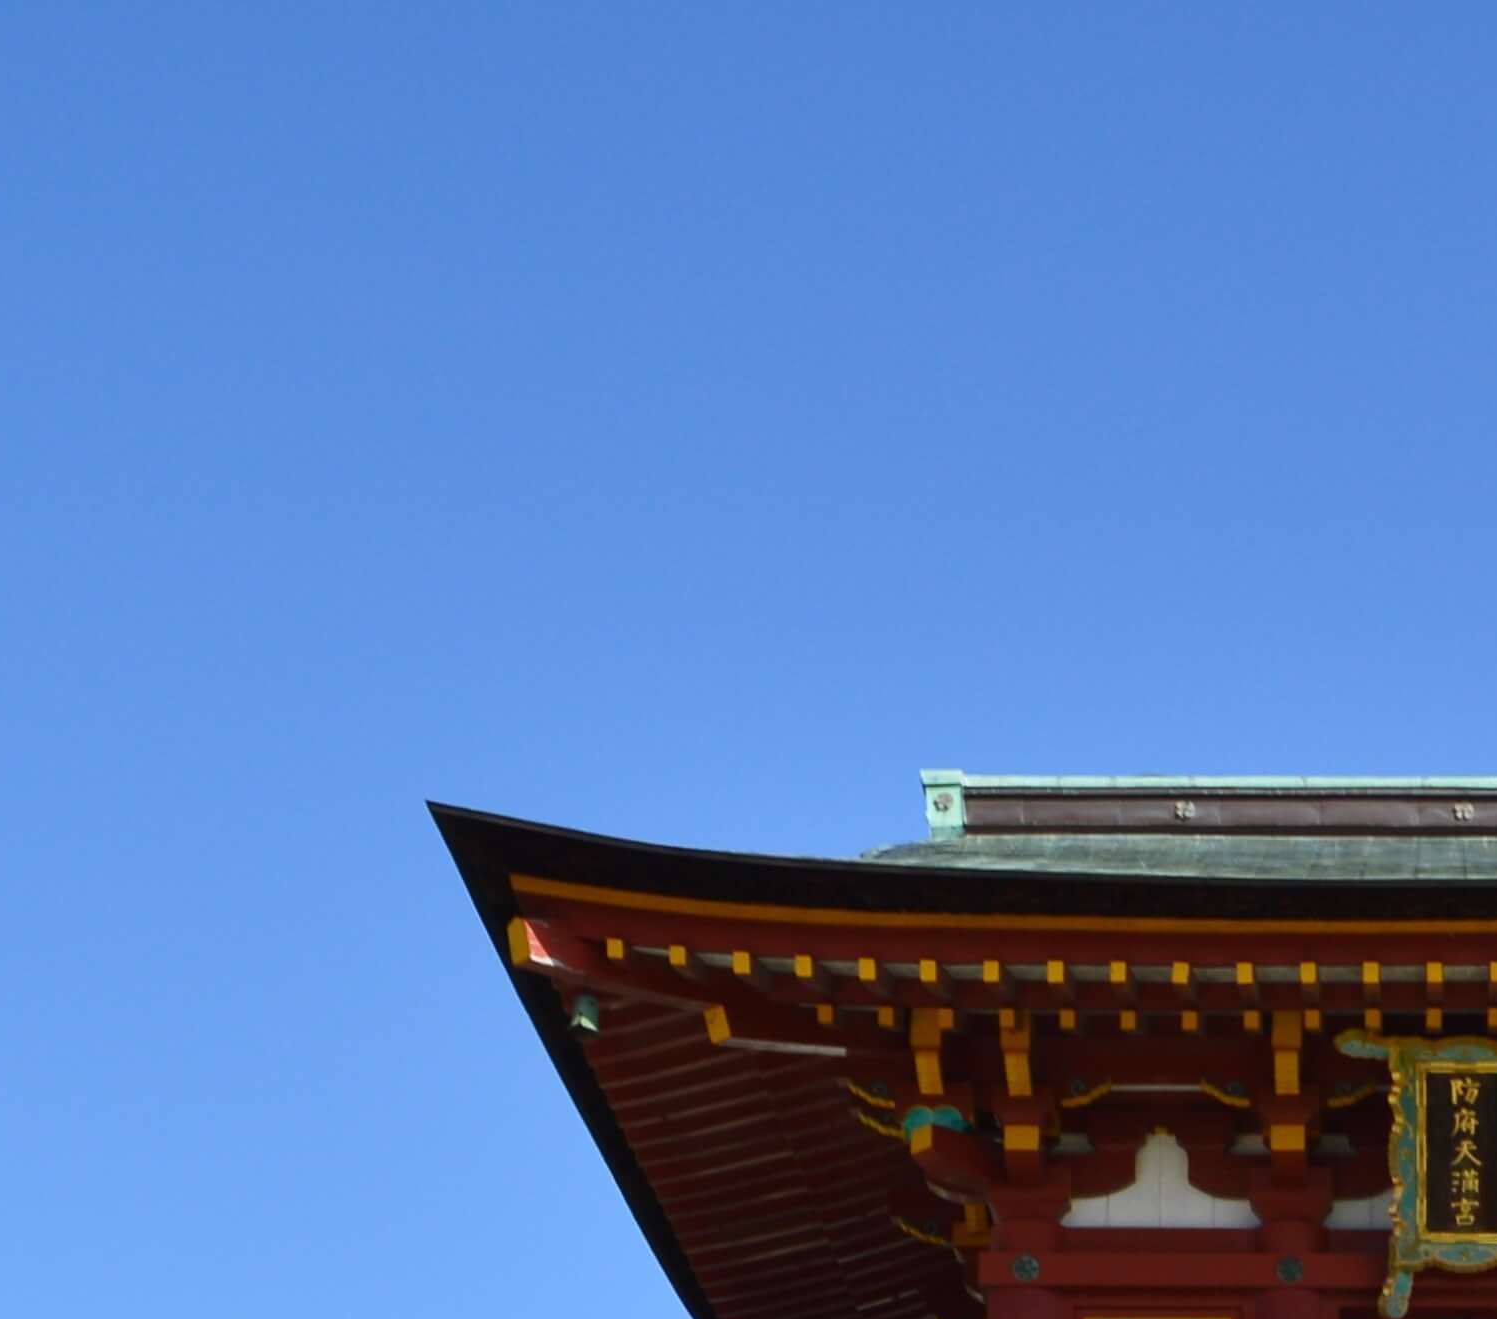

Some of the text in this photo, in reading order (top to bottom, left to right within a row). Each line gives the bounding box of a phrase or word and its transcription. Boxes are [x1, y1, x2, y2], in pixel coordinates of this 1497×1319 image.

[1449, 1076, 1483, 1226] 防府天満宮
